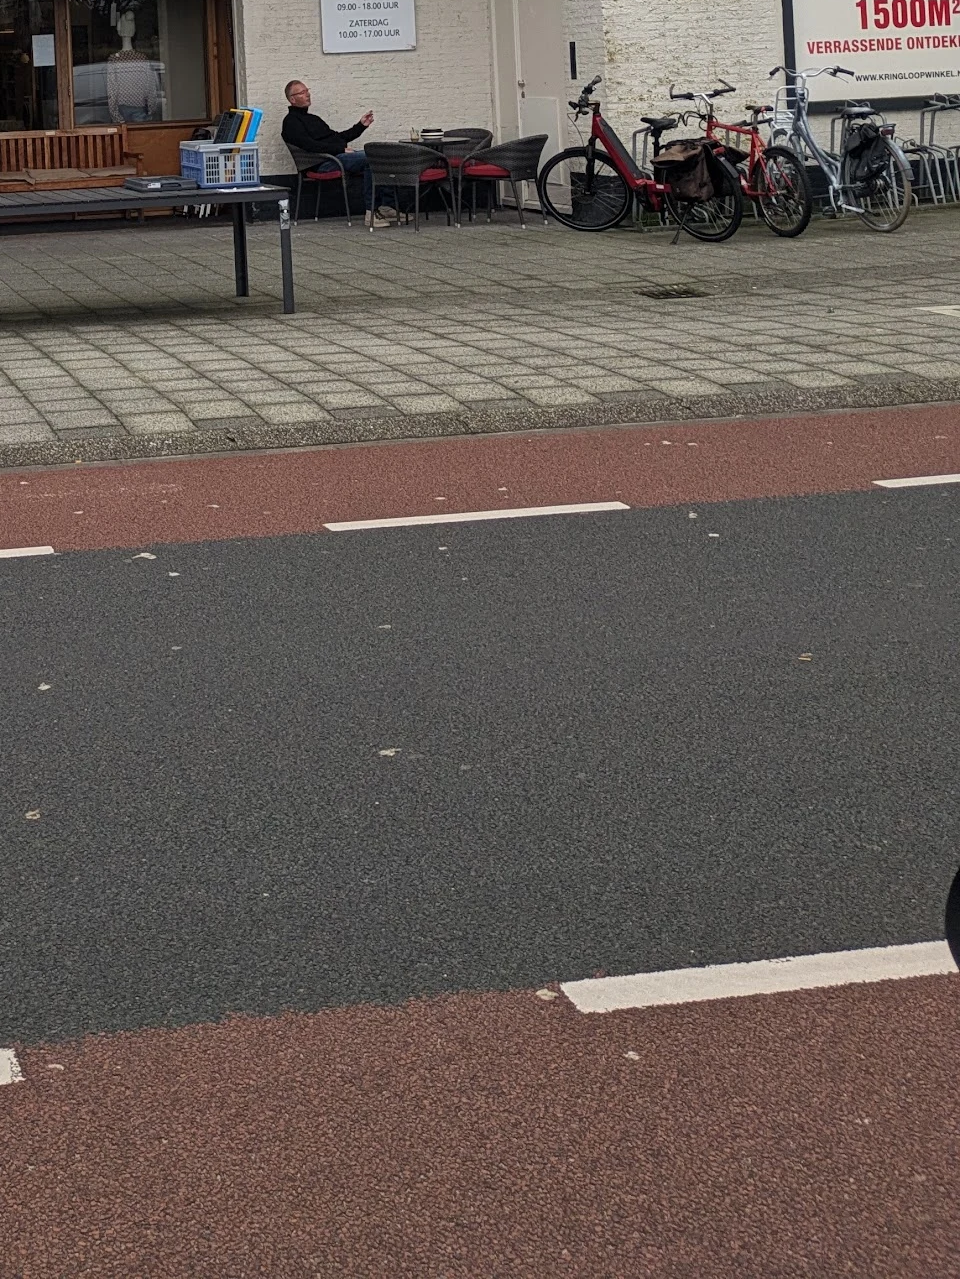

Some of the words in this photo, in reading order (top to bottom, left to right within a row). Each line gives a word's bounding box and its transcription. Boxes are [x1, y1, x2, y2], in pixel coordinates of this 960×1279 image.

[337, 3, 356, 11] 09.00
[363, 2, 381, 10] 18.00
[349, 18, 389, 27] ZATERDAG
[364, 30, 383, 38] 17.00
[384, 29, 400, 37] UUR
[807, 37, 903, 54] VERRASSENDE
[907, 35, 960, 50] ONTDEK
